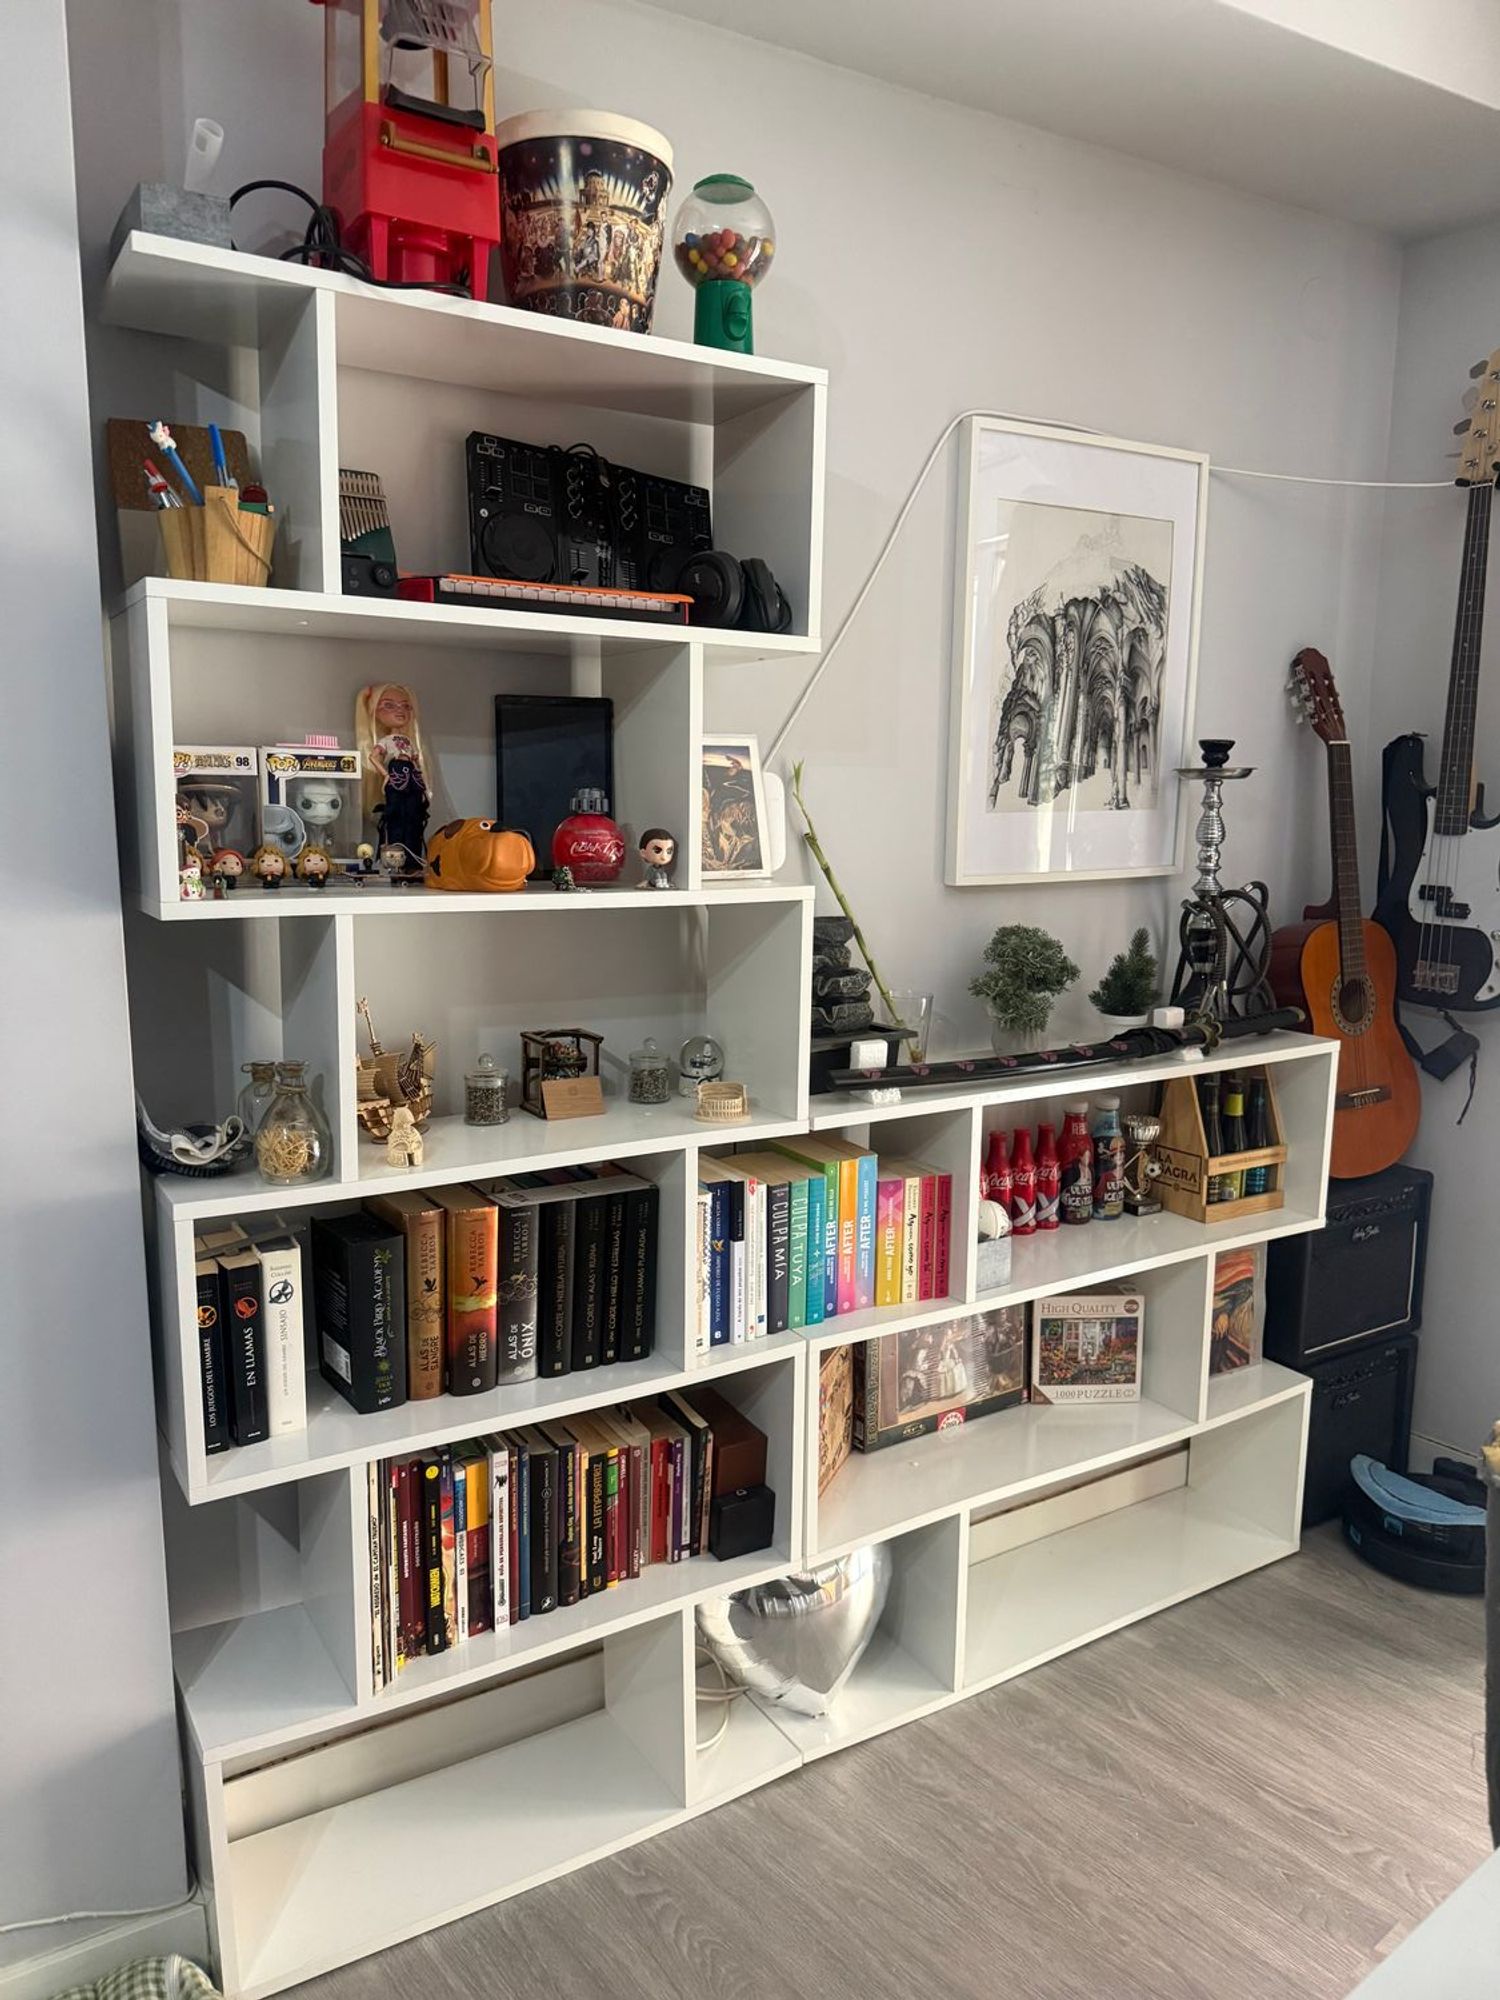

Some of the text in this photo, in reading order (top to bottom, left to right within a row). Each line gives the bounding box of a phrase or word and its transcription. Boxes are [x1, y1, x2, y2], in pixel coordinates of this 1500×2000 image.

[235, 756, 250, 767] 98
[266, 756, 299, 772] POP!
[1158, 1151, 1173, 1165] LA
[477, 1231, 485, 1267] YARROS
[512, 1221, 521, 1262] REBECCA
[521, 1222, 529, 1258] YARROS
[637, 1228, 647, 1267] PLATEADAS
[772, 1202, 789, 1280] CULPA MÍA
[792, 1198, 808, 1286] CULPA TUYA
[826, 1220, 836, 1256] AFTER
[843, 1220, 854, 1255] AFTER
[860, 1215, 871, 1249] AFTER
[885, 1226, 896, 1256] AFTER
[421, 1233, 429, 1275] REBECCA
[429, 1234, 437, 1272] YARROS
[470, 1230, 478, 1272] REBECCA
[587, 1274, 596, 1293] ALAS
[635, 1268, 645, 1295] LLAMAS
[373, 1255, 386, 1358] BLACK BIRD ACADEMY
[554, 1311, 565, 1337] CORTE
[586, 1303, 595, 1328] CORTE
[608, 1306, 618, 1329] CORTE
[634, 1303, 644, 1326] CORTE
[1041, 1303, 1069, 1314] HIGH
[1071, 1302, 1118, 1315] QUALITY
[279, 1309, 288, 1341] SINSAJO
[508, 1323, 519, 1360] ALAS DE
[519, 1321, 534, 1358] ÓNIX
[203, 1337, 213, 1368] HAMBRE
[243, 1327, 256, 1386] EN LLAMAS
[420, 1337, 429, 1372] ALAS DE
[430, 1335, 439, 1370] SANGRE
[468, 1334, 477, 1367] ALAS DE
[479, 1332, 487, 1362] HIERRO
[208, 1385, 216, 1412] JUEGOS
[1055, 1388, 1122, 1399] 1000 PUZZLE
[867, 1393, 878, 1444] EDUCA
[593, 1462, 602, 1529] LA EMPERATRIZ
[429, 1567, 441, 1608] WATCHMEN
